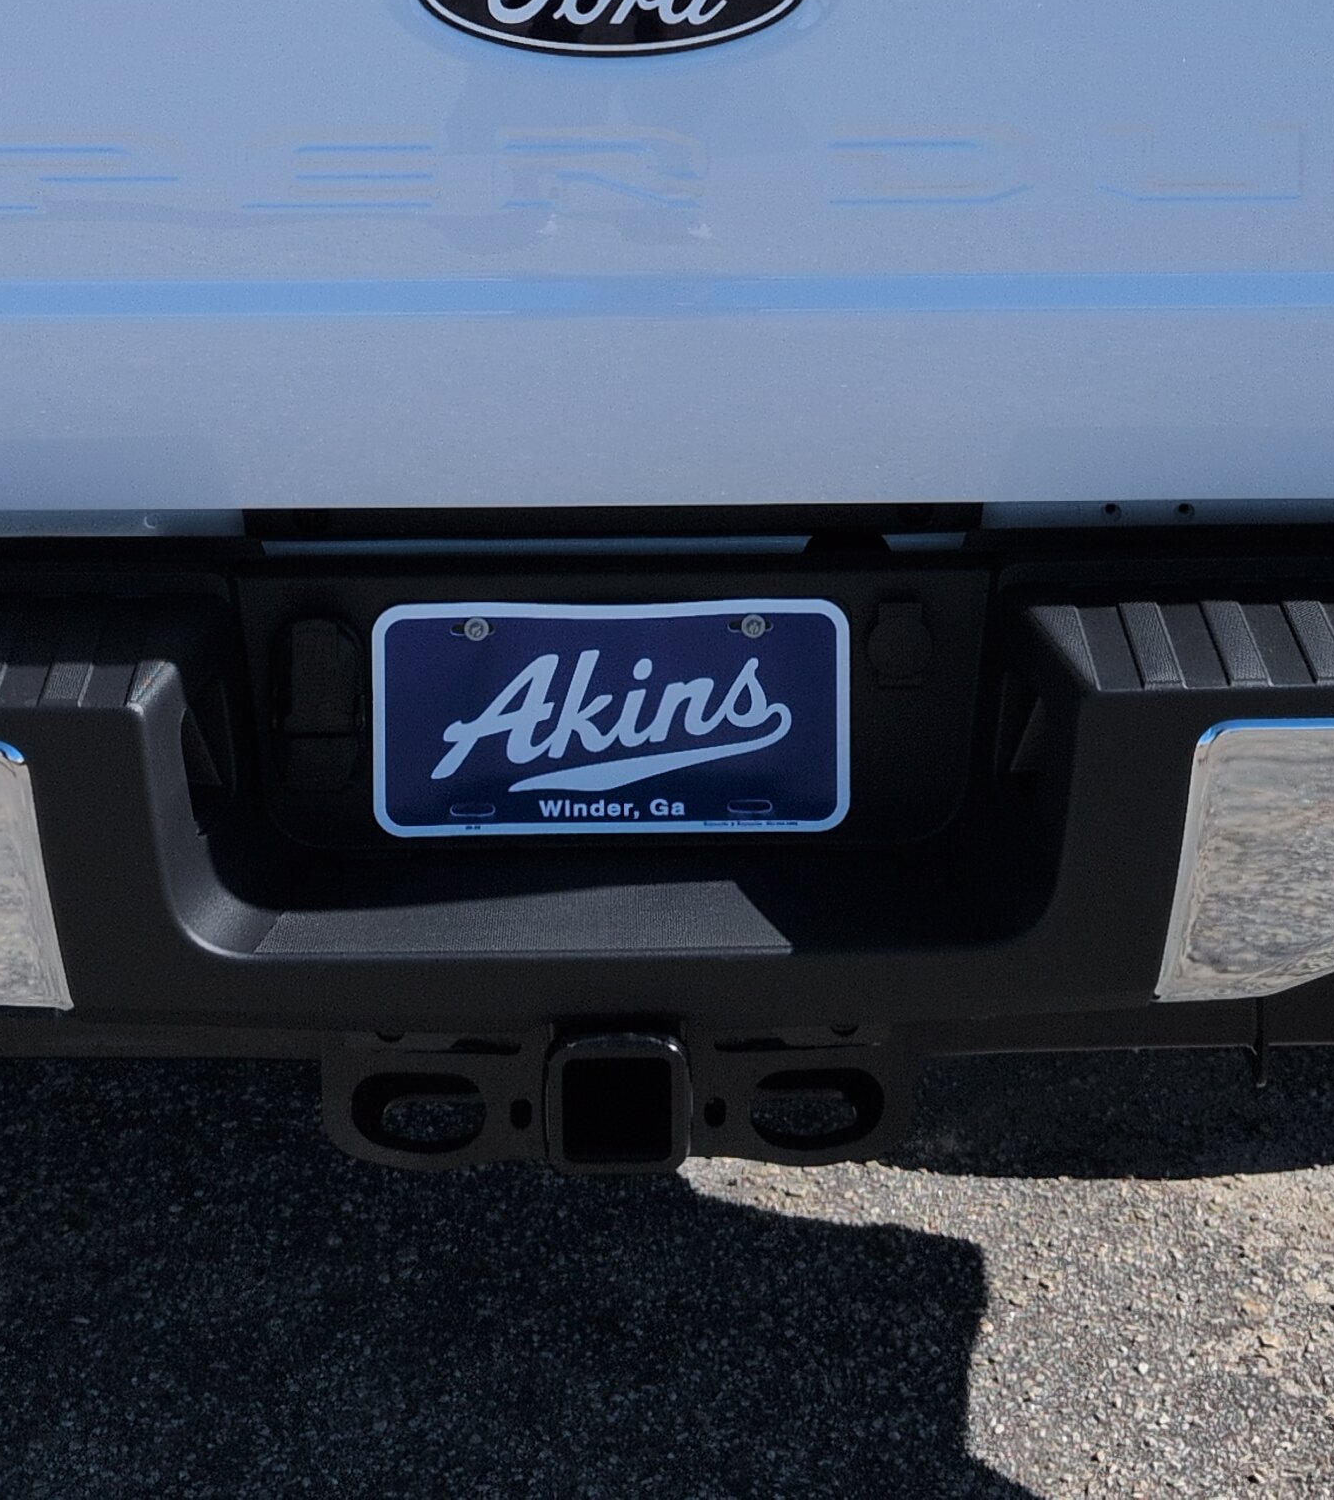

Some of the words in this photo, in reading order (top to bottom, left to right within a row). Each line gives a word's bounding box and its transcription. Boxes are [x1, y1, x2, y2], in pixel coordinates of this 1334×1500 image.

[430, 649, 793, 792] Akins
[538, 799, 641, 820] Winder,
[649, 798, 686, 817] Ga
